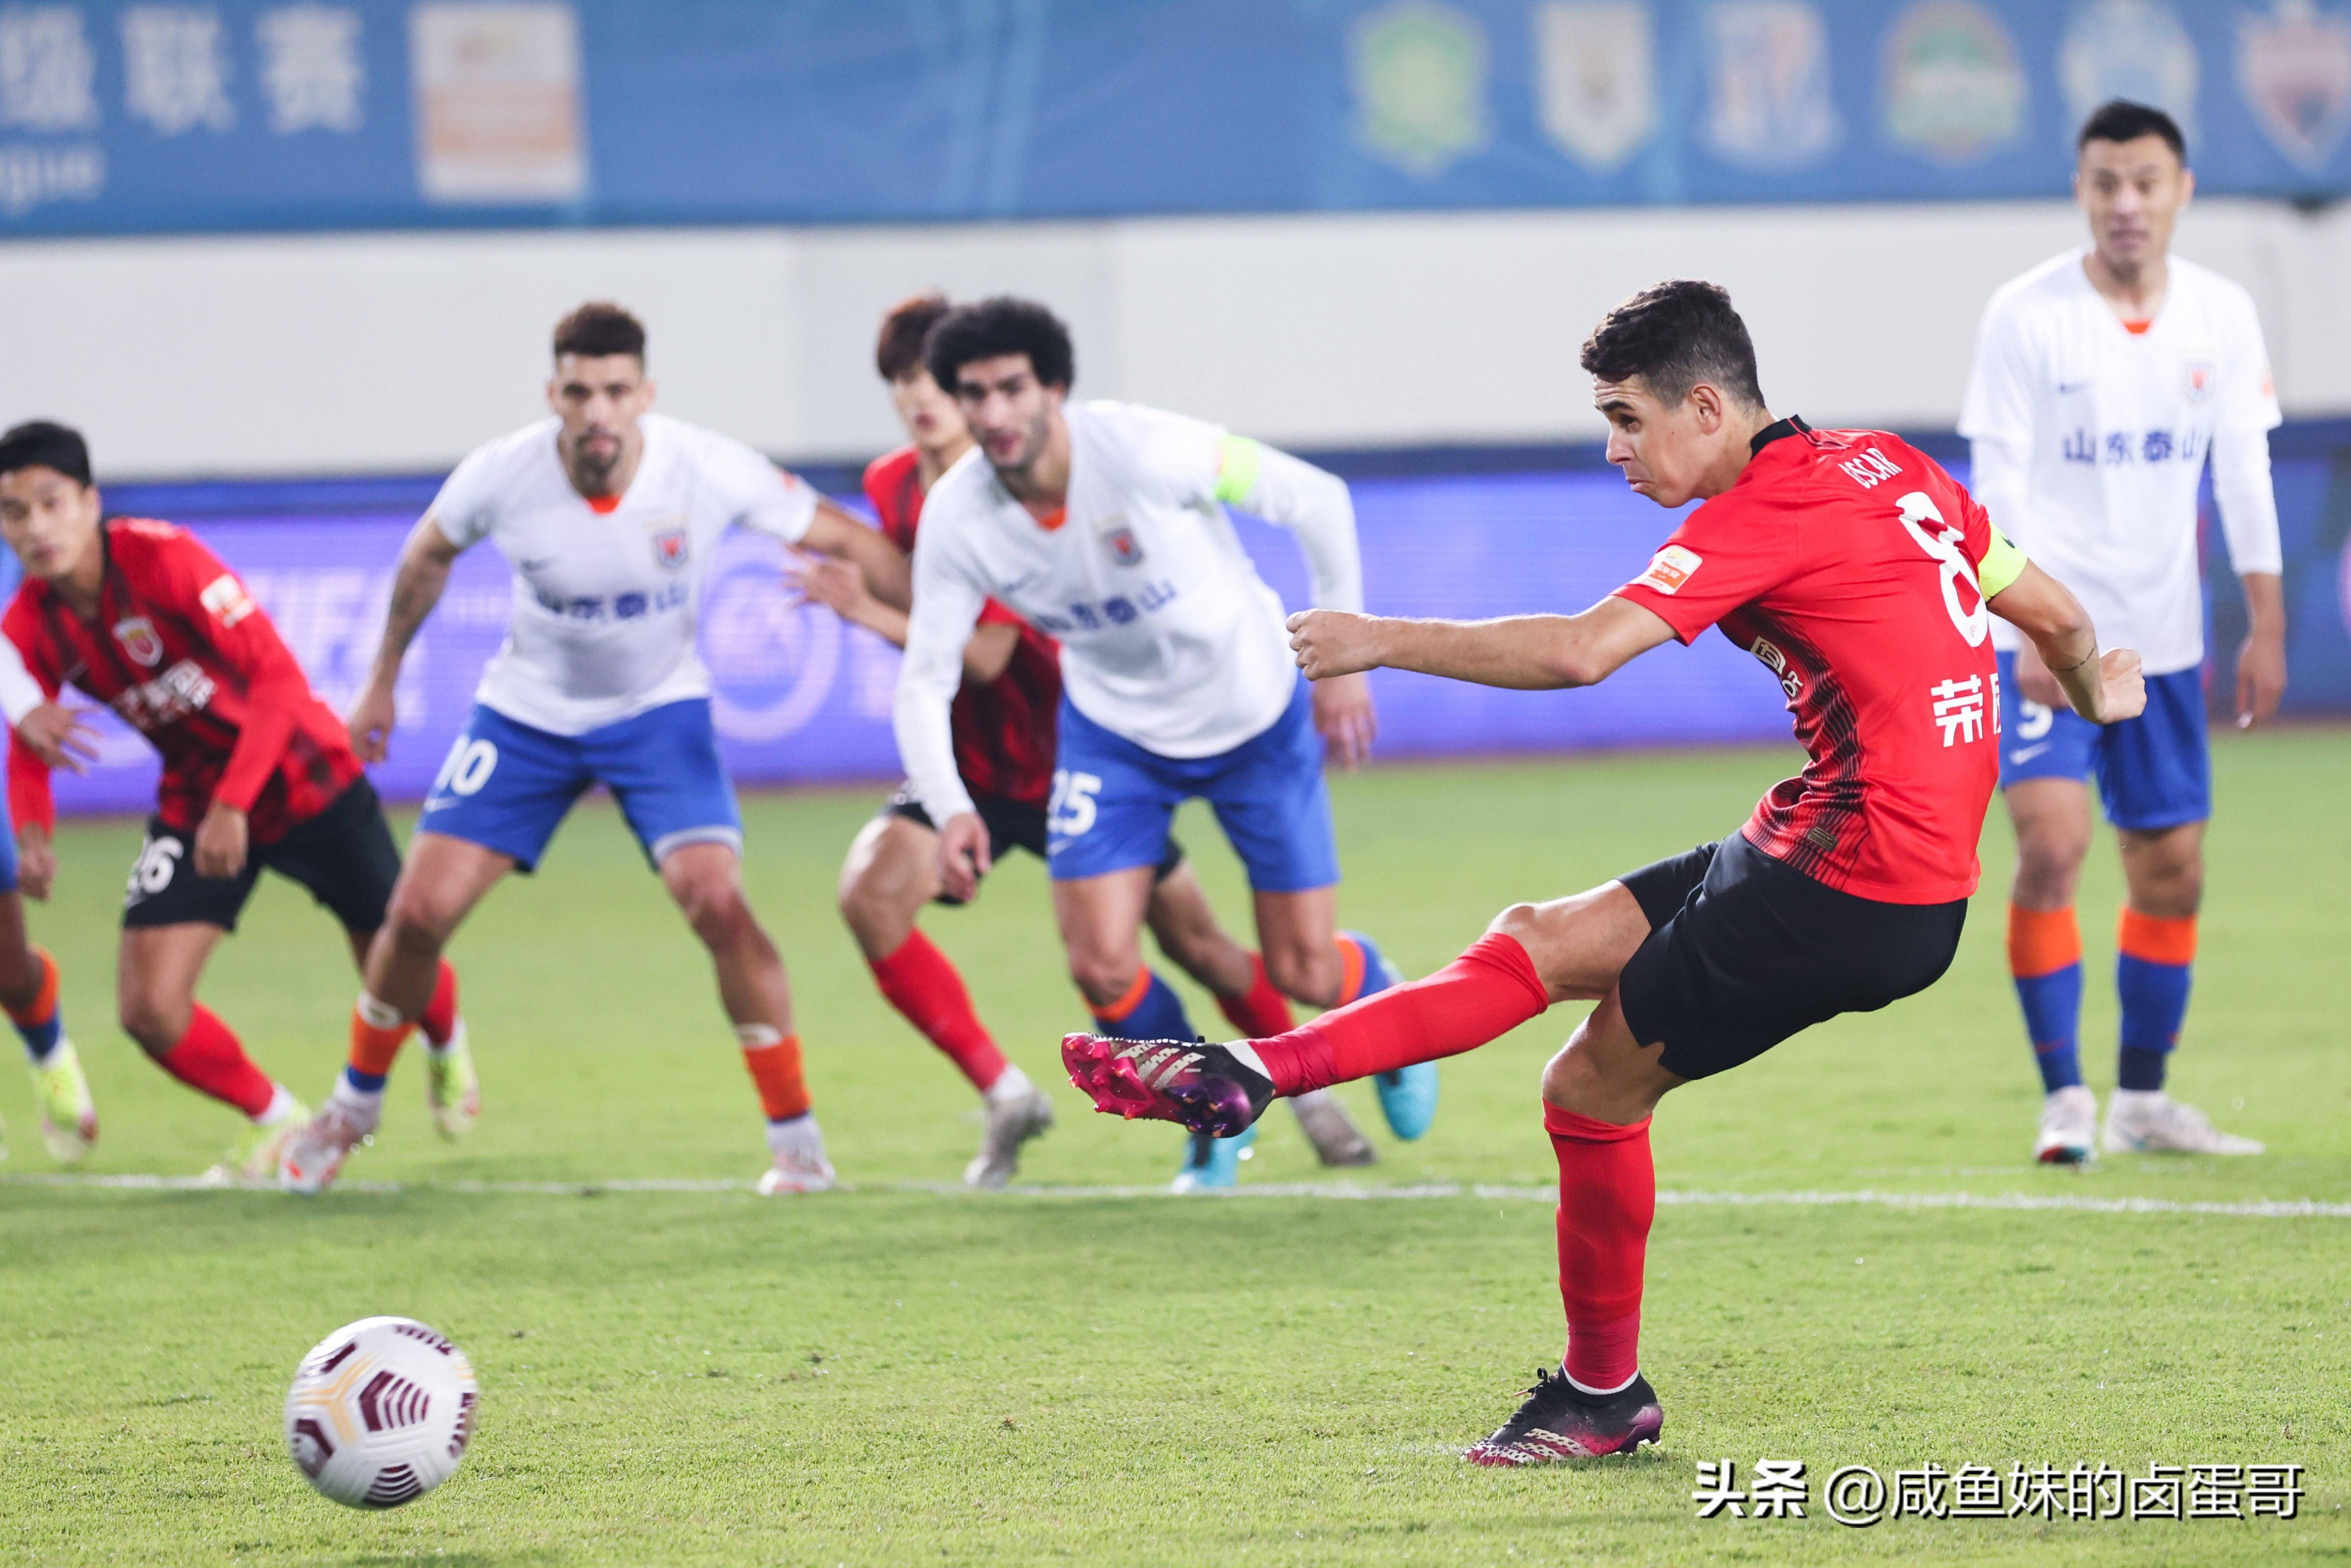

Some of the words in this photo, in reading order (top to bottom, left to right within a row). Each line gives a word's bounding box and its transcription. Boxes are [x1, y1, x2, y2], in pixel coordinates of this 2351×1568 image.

[1837, 447, 1903, 490] OSCAR
[1895, 491, 1989, 648] 8
[434, 734, 499, 797] 10
